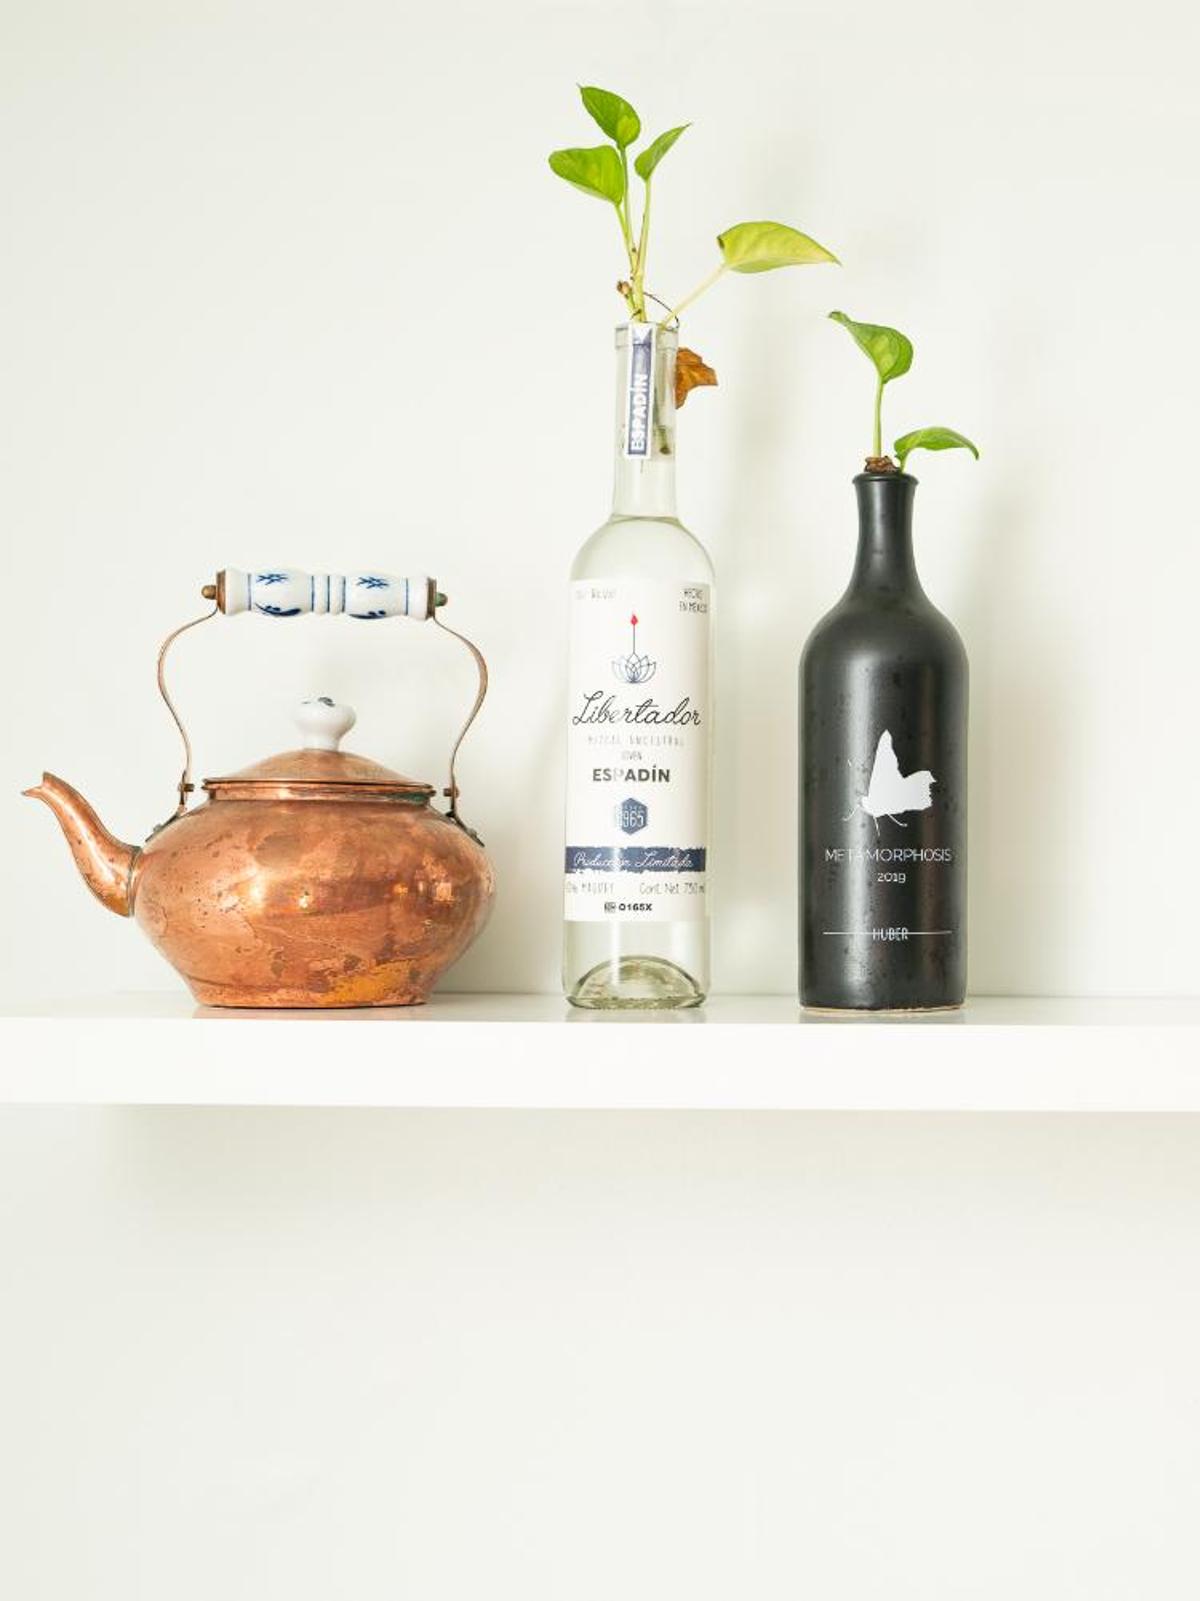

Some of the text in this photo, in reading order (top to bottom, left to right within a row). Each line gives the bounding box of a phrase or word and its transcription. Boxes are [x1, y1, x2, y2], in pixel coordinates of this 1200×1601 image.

[572, 690, 702, 726] Libertador
[592, 763, 671, 783] ESPADÍN
[824, 848, 953, 863] METAMORPHOSIS
[876, 872, 907, 884] 2019
[872, 927, 909, 942] HUBER
